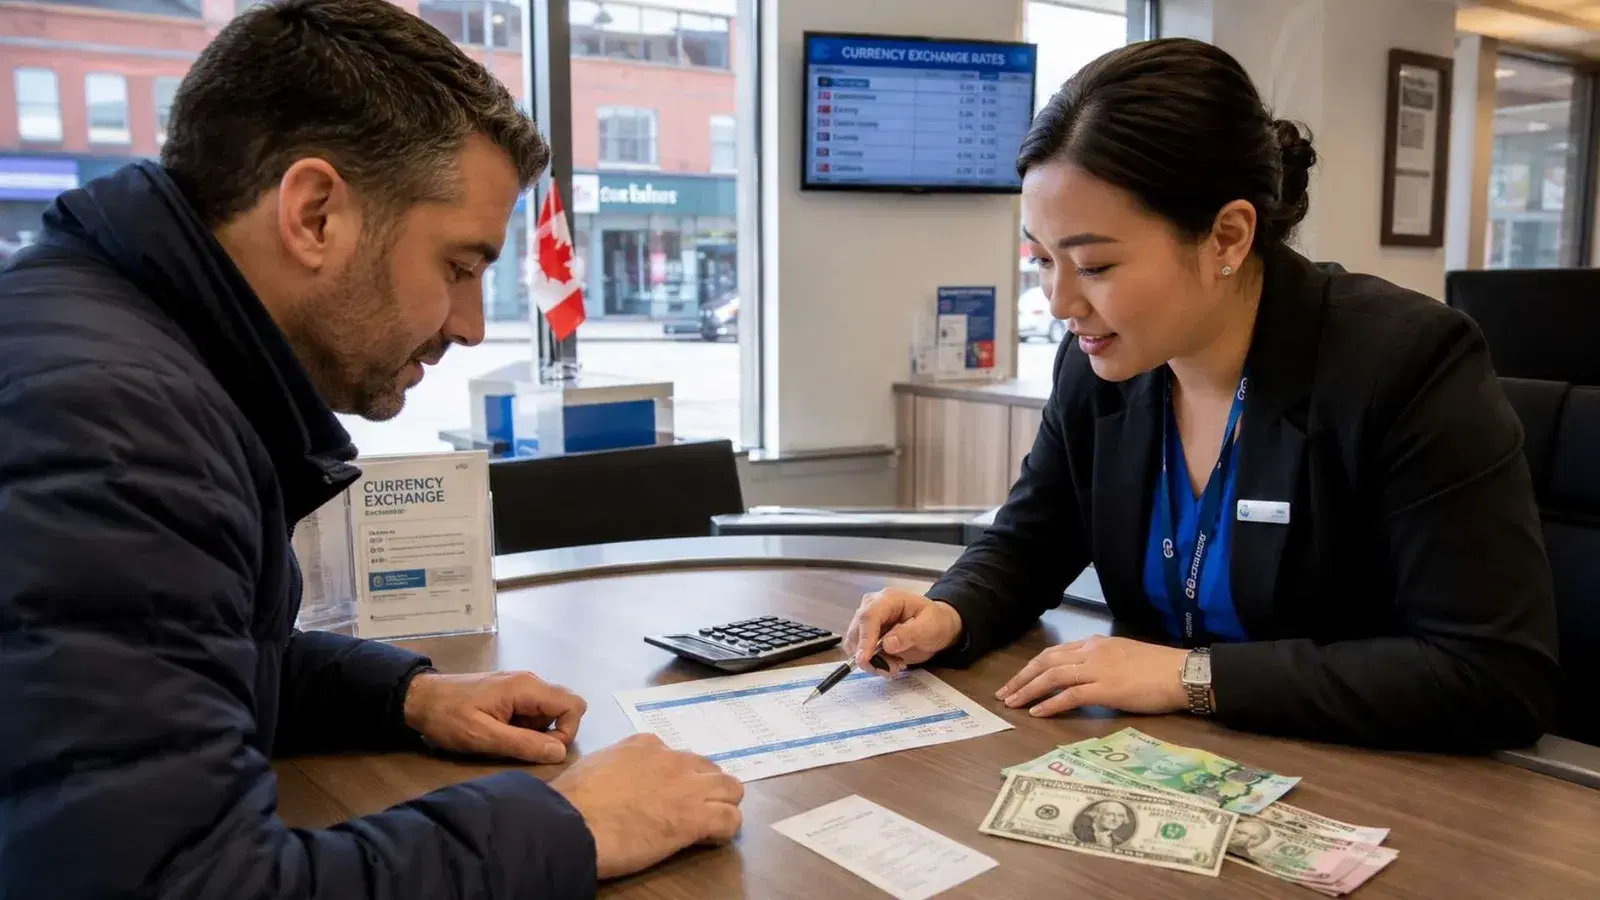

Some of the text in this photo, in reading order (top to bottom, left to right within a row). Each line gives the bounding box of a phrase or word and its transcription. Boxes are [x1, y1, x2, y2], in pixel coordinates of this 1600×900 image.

[841, 46, 1005, 66] CURRENCY EXCHANGE RATES
[363, 476, 444, 493] CURRENCY
[364, 490, 445, 507] EXCHANGE
[1087, 745, 1130, 762] 20
